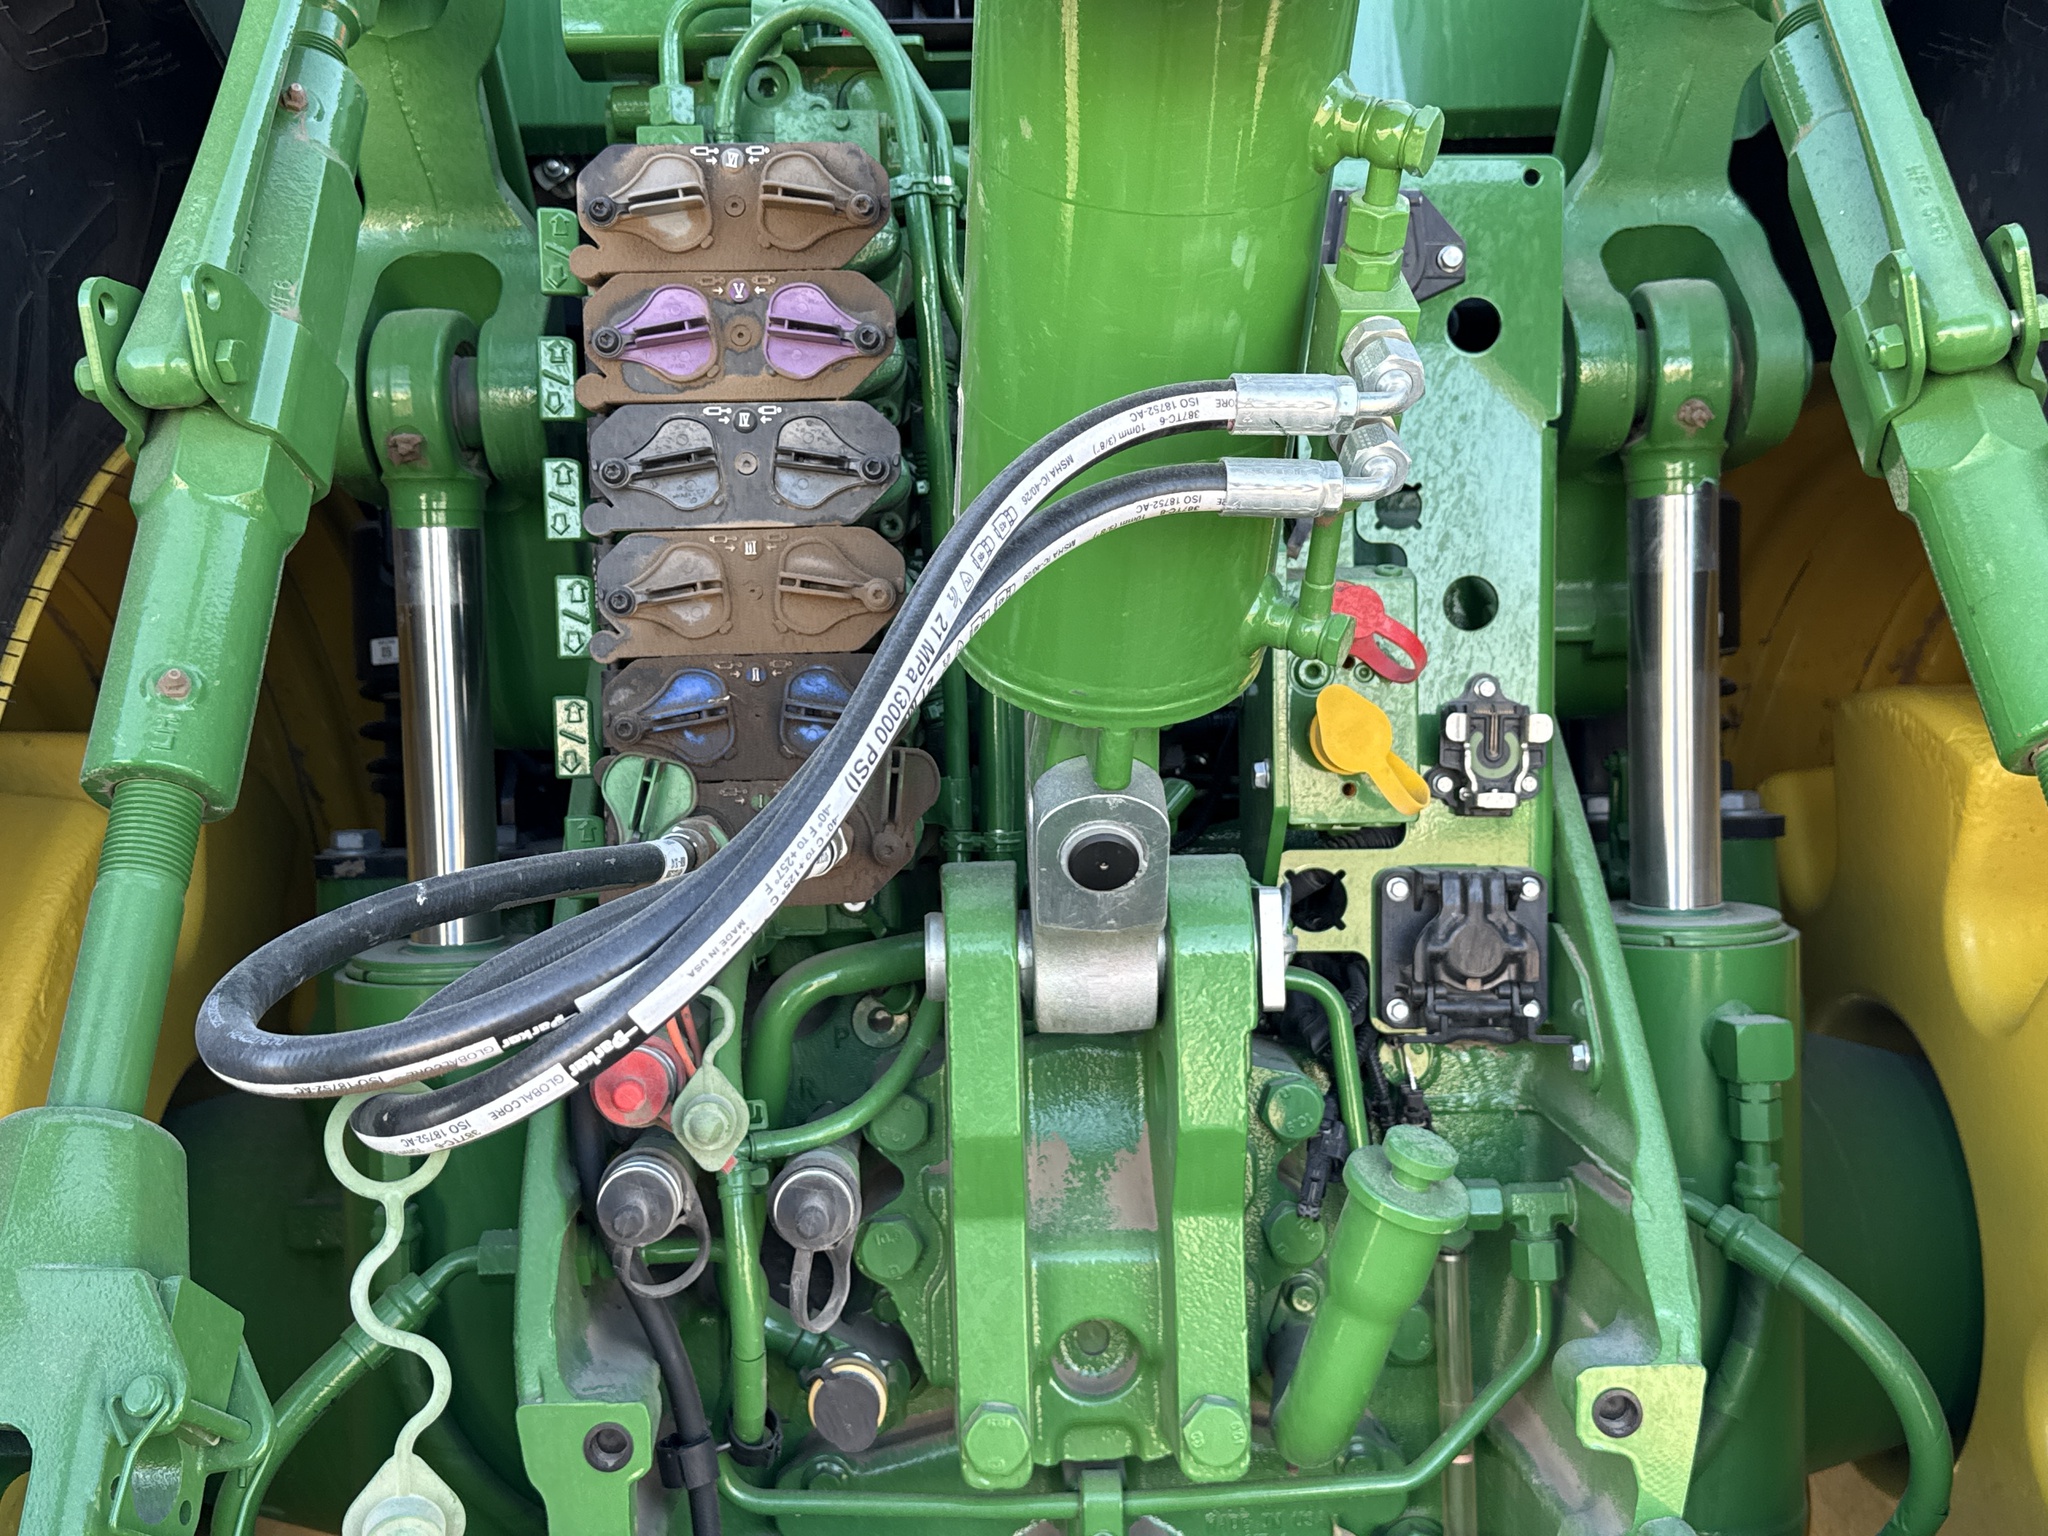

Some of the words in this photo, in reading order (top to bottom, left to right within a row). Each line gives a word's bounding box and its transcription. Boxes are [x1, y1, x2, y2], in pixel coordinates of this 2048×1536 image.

[732, 283, 745, 298] V
[1179, 396, 1199, 408] ISO
[1129, 401, 1177, 422] 18752-AC
[1159, 409, 1200, 425] 387TC-6
[738, 413, 750, 427] IV
[1118, 423, 1146, 440] 10mm
[1049, 454, 1075, 478] MSHA
[1021, 473, 1050, 506] IC-40/26
[1135, 496, 1180, 514] 18752-AC
[1183, 494, 1202, 504] ISO
[744, 540, 757, 555] III
[930, 612, 948, 641] 21
[905, 638, 935, 683] MPa
[751, 668, 760, 682] II
[874, 685, 911, 745] (3000
[844, 742, 879, 793] PSI)
[809, 825, 818, 838] F
[796, 836, 810, 850] TO
[816, 836, 825, 848] C
[805, 847, 816, 861] TO
[764, 882, 773, 896] F
[770, 895, 780, 907] C
[719, 919, 747, 947] MADE
[708, 946, 721, 959] IN
[687, 958, 710, 978] USA
[502, 1013, 566, 1049] Parker
[568, 1028, 633, 1077] Parker
[488, 1073, 565, 1121] GLOBALCORE
[448, 1119, 472, 1133] ISO
[400, 1128, 448, 1148] 18752-AC
